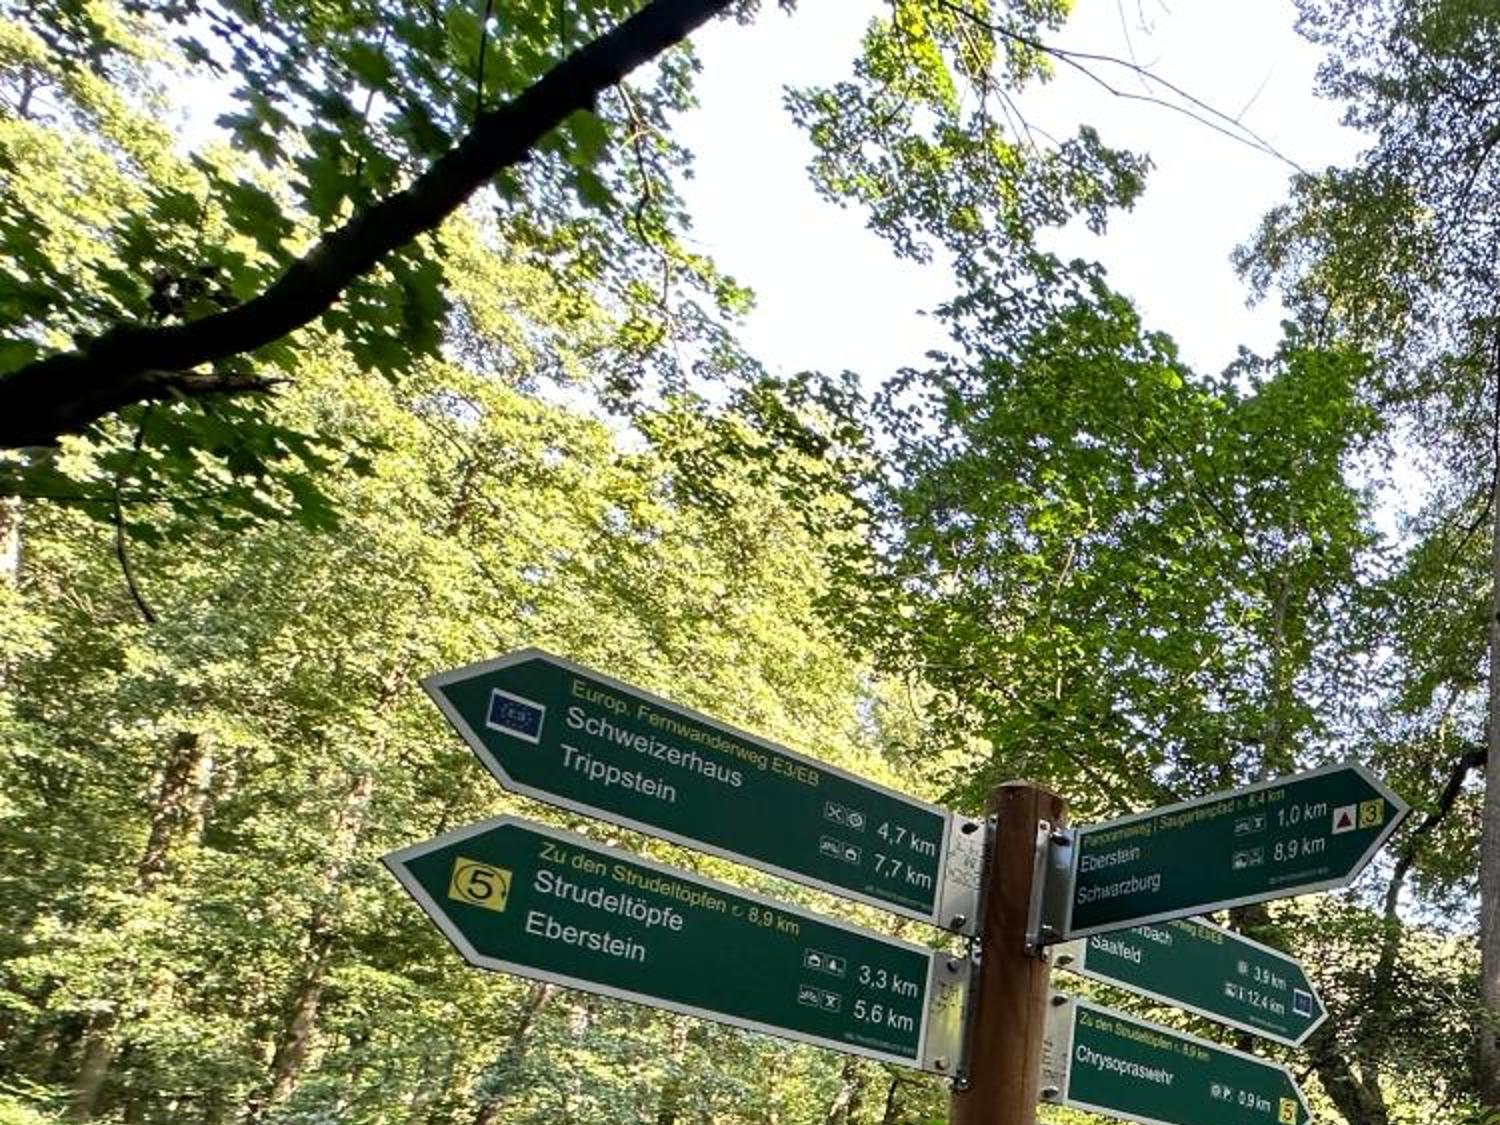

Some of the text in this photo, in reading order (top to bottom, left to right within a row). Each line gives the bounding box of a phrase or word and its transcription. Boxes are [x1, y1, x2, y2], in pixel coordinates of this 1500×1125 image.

[571, 680, 631, 717] Europ.
[636, 705, 768, 771] Fernwanderweg
[561, 743, 677, 803] Trippstein
[874, 853, 903, 878] 7,7
[904, 864, 932, 891] km
[566, 706, 936, 857] Schweizerhaus 4,7 km
[1364, 804, 1377, 824] 3
[1077, 837, 1326, 905] Schwarzburg 8,9 km
[1079, 801, 1328, 873] Eberstein 1,0 km
[466, 869, 495, 900] 5
[538, 841, 801, 937] Zu den Strudeltöpfen 8,9 km
[525, 909, 647, 963] Eberstein
[887, 1008, 914, 1032] km
[533, 868, 684, 932] Strudeltöpfe
[858, 964, 888, 989] 3,3
[892, 974, 919, 998] km
[1091, 934, 1142, 963] Saalfeld
[1269, 997, 1286, 1015] km
[1271, 972, 1287, 990] km
[1076, 1045, 1174, 1085] Chrysopraswehr
[1256, 1095, 1271, 1112] km
